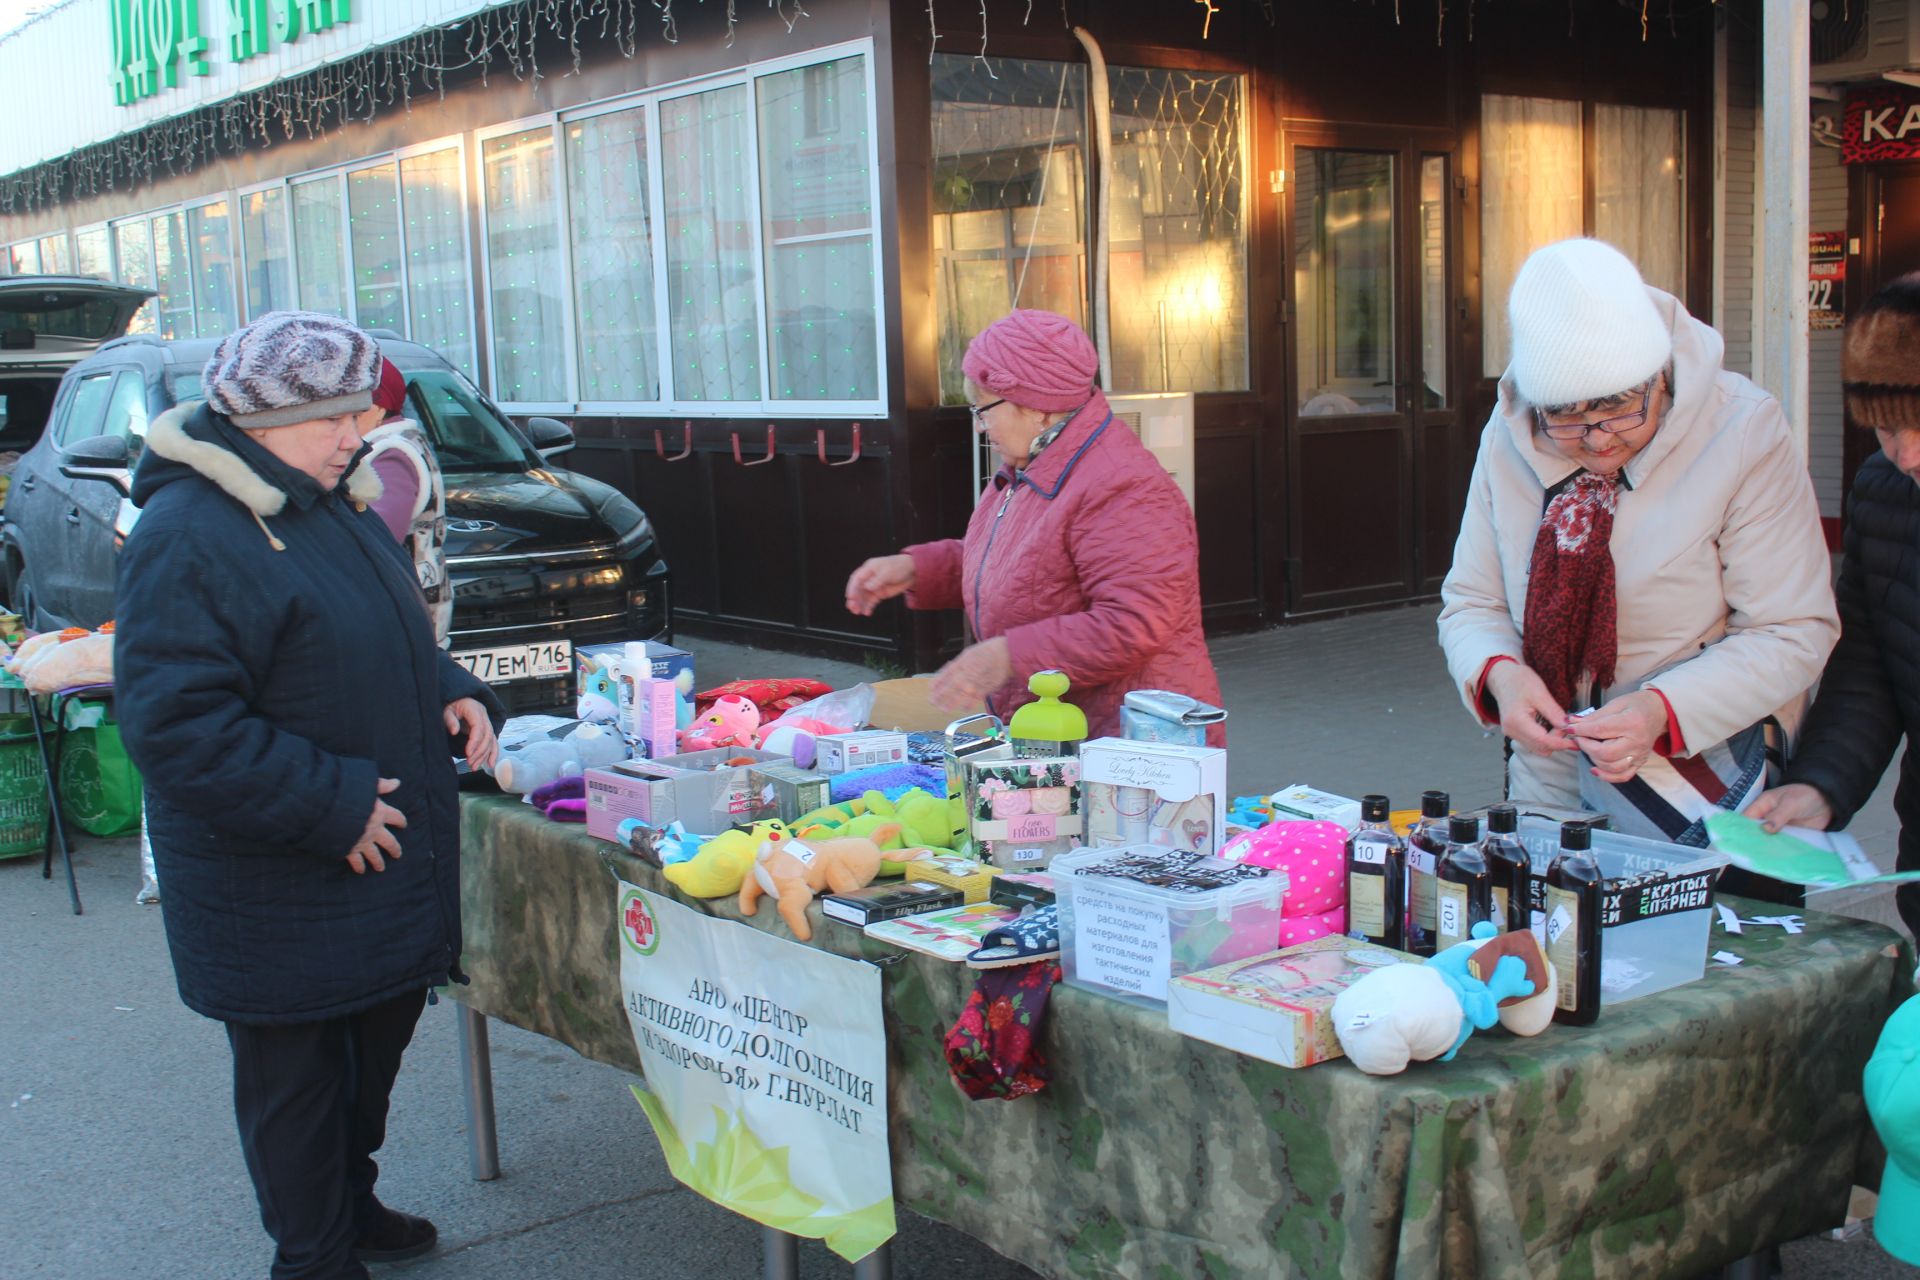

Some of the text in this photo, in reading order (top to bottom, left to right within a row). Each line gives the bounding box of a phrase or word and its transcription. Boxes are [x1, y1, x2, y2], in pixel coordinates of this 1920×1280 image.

[530, 645, 565, 665] 716
[1013, 826, 1050, 839] FLOWERS
[1357, 845, 1374, 861] 10
[1651, 874, 1710, 899] КРУТЫХ
[1076, 896, 1165, 924] средств на покупку
[1442, 903, 1454, 930] 102
[1097, 914, 1146, 932] расходных
[1086, 927, 1158, 950] материалов для
[1091, 942, 1154, 964] изготовления
[1095, 957, 1151, 978] тактических
[1103, 974, 1142, 990] изделий
[688, 977, 808, 1037] АНО «ЦЕНТР
[629, 990, 874, 1107] АКТИВНОГО ДОЛГОЛЕТИЯ
[766, 1072, 862, 1134] Г.НУРЛАТ
